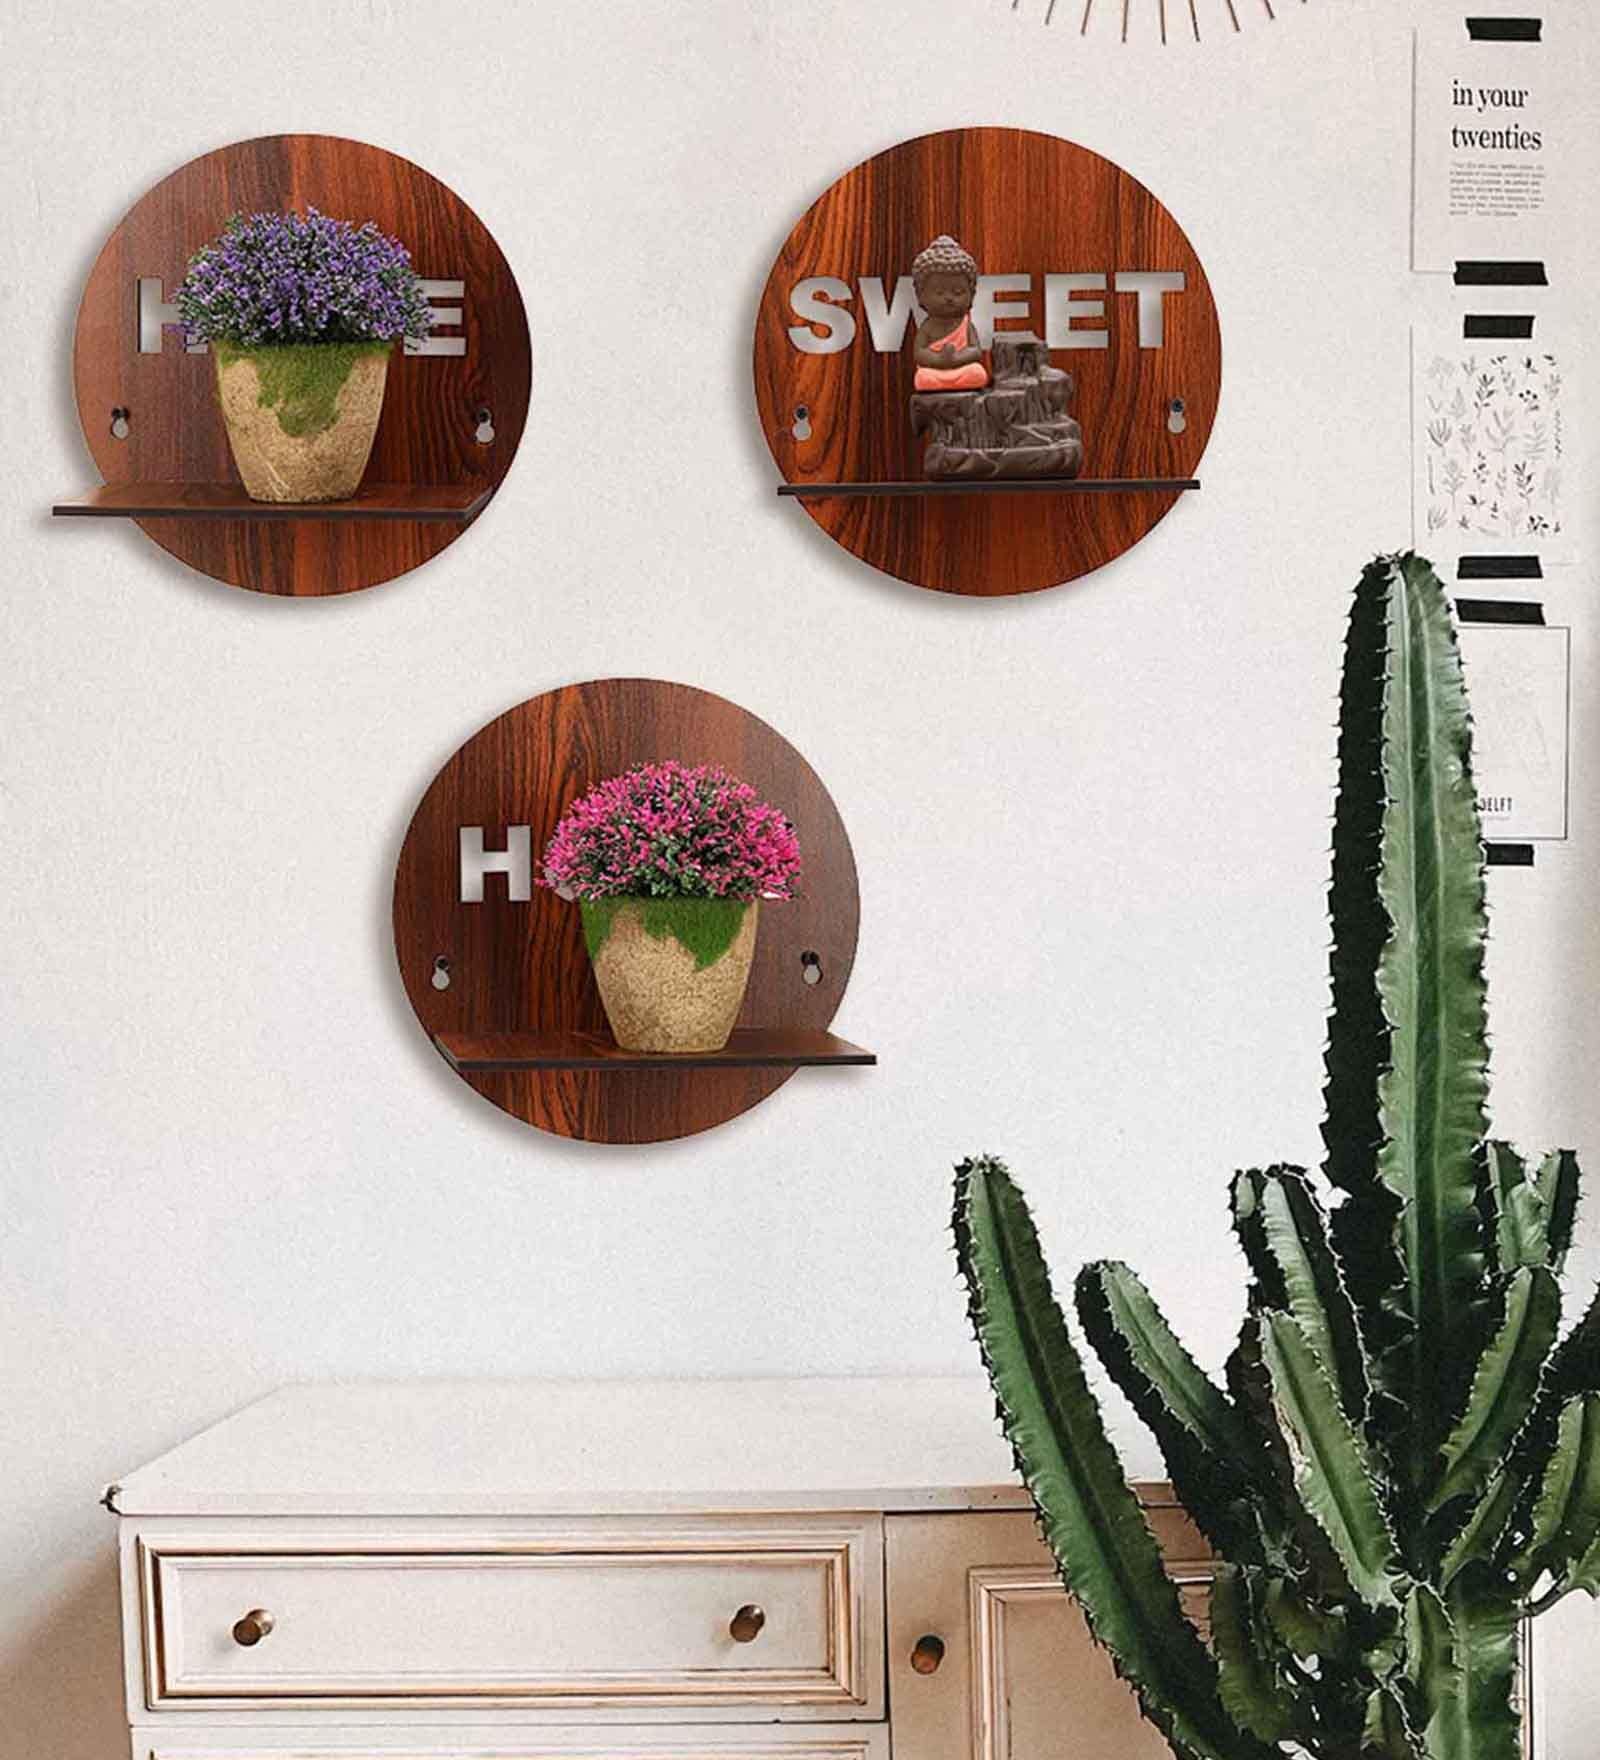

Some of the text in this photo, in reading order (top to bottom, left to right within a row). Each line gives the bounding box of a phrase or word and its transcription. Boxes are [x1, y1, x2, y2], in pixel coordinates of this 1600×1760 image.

[1453, 79, 1529, 113] in your
[1452, 123, 1542, 150] twenties
